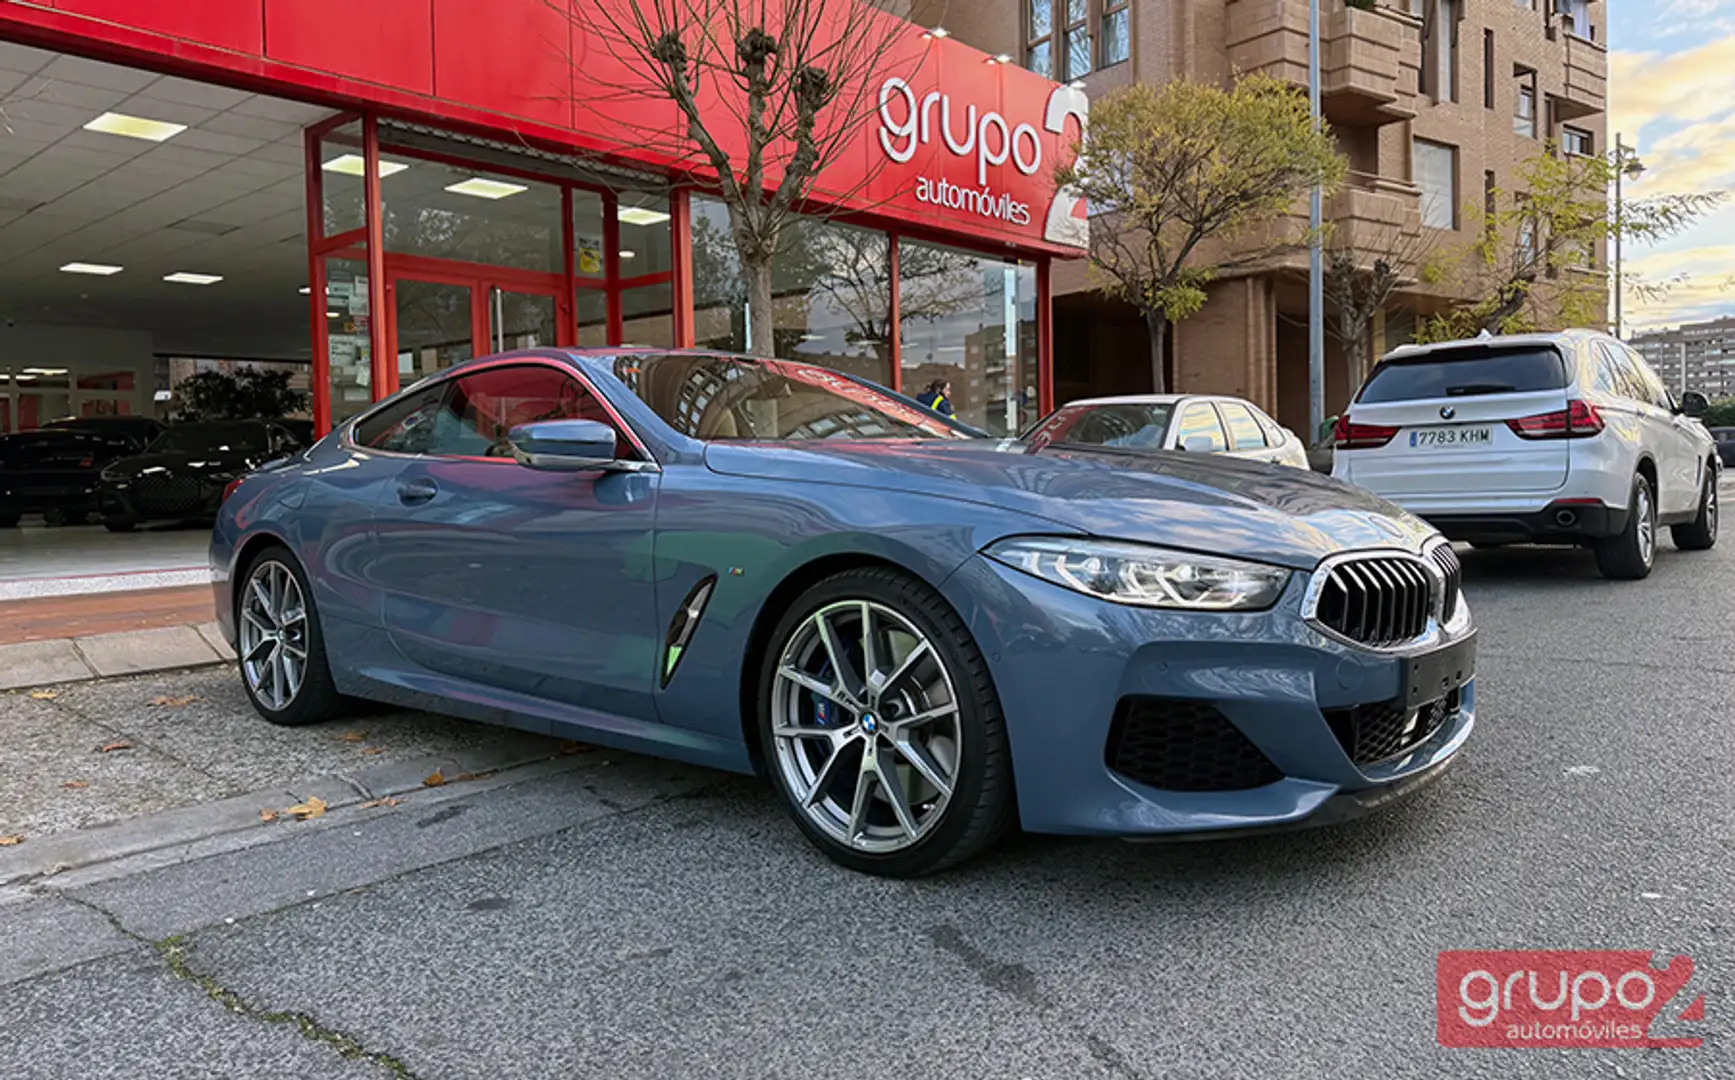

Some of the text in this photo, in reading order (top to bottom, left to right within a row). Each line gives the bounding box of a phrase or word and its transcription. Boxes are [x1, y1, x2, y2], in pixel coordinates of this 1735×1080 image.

[879, 77, 1042, 186] grupo
[915, 176, 1031, 226] automóviles
[1419, 429, 1490, 445] 7783 KHM
